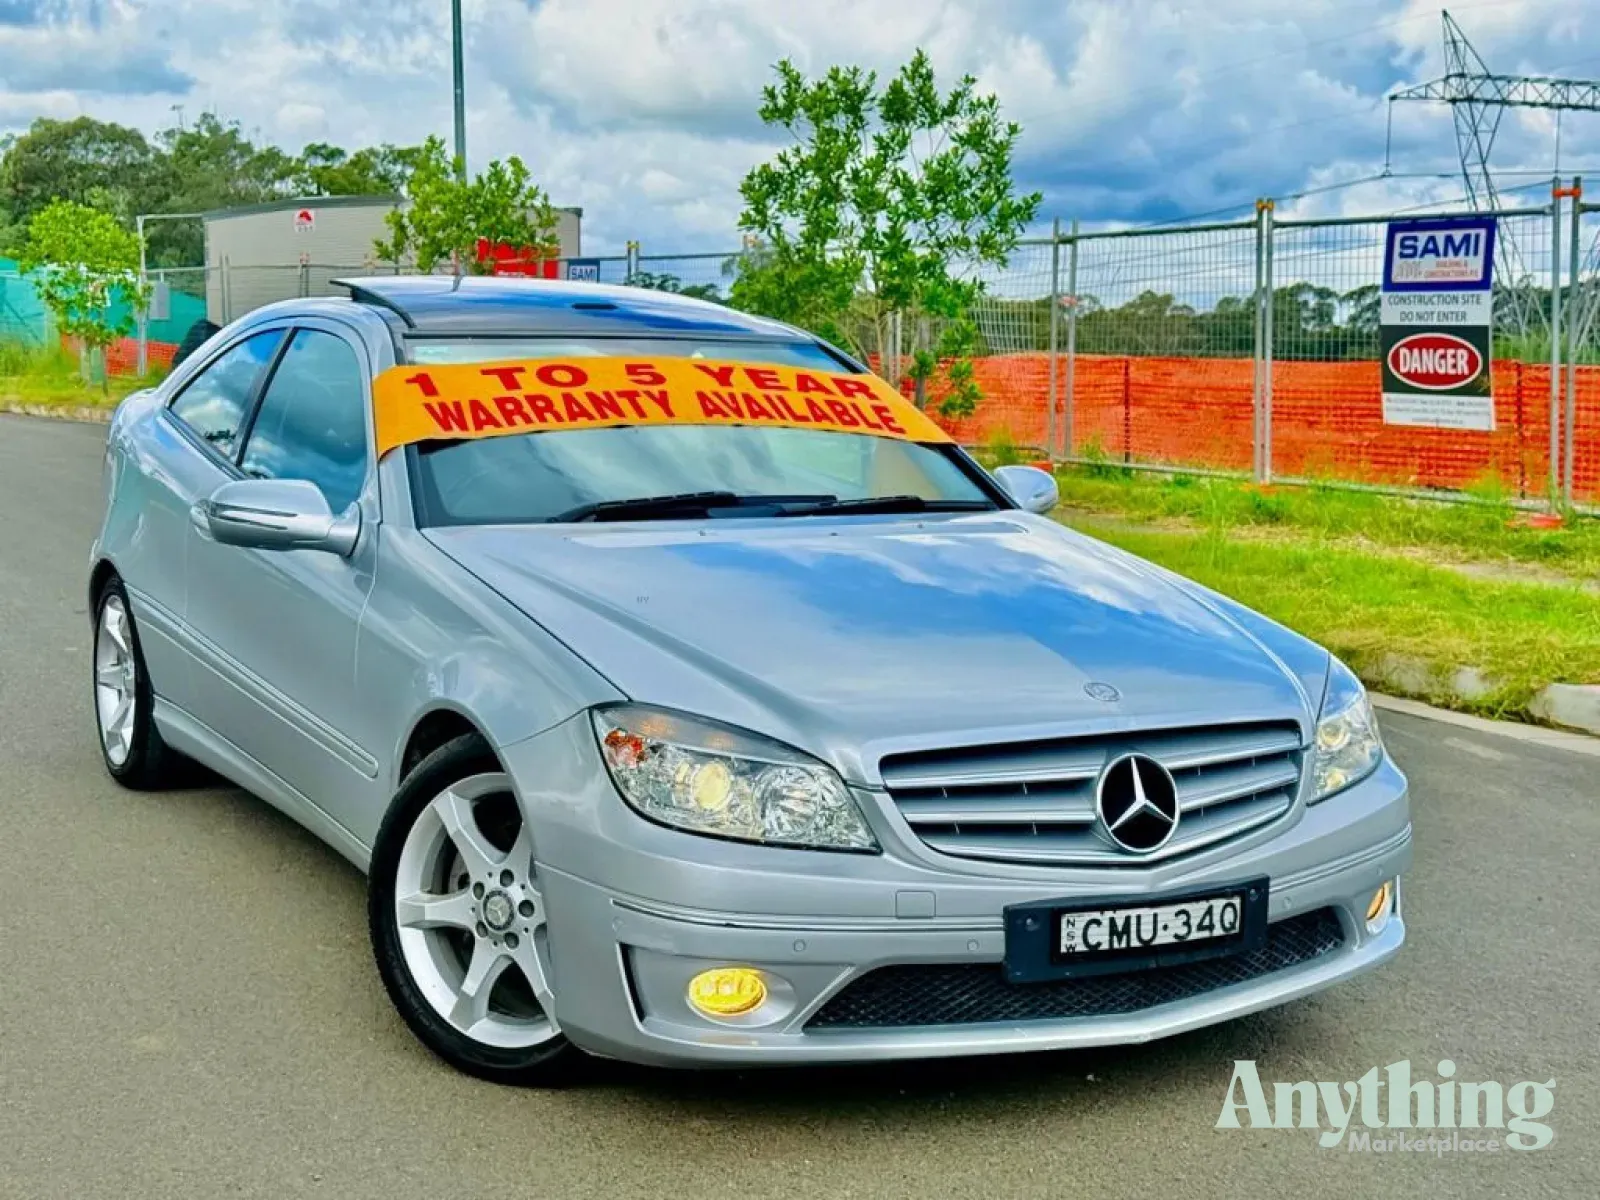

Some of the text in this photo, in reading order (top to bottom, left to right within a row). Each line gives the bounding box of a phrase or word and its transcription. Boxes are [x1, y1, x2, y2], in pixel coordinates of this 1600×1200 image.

[1398, 232, 1480, 258] SAMI
[1387, 293, 1481, 306] CONSTRUCTION SITE
[1399, 310, 1467, 322] DO NOT ENTER
[1399, 347, 1470, 375] DANGER
[405, 363, 881, 400] 1 TO 5 YEAR
[422, 390, 907, 435] WARRANTY AVAILABLE
